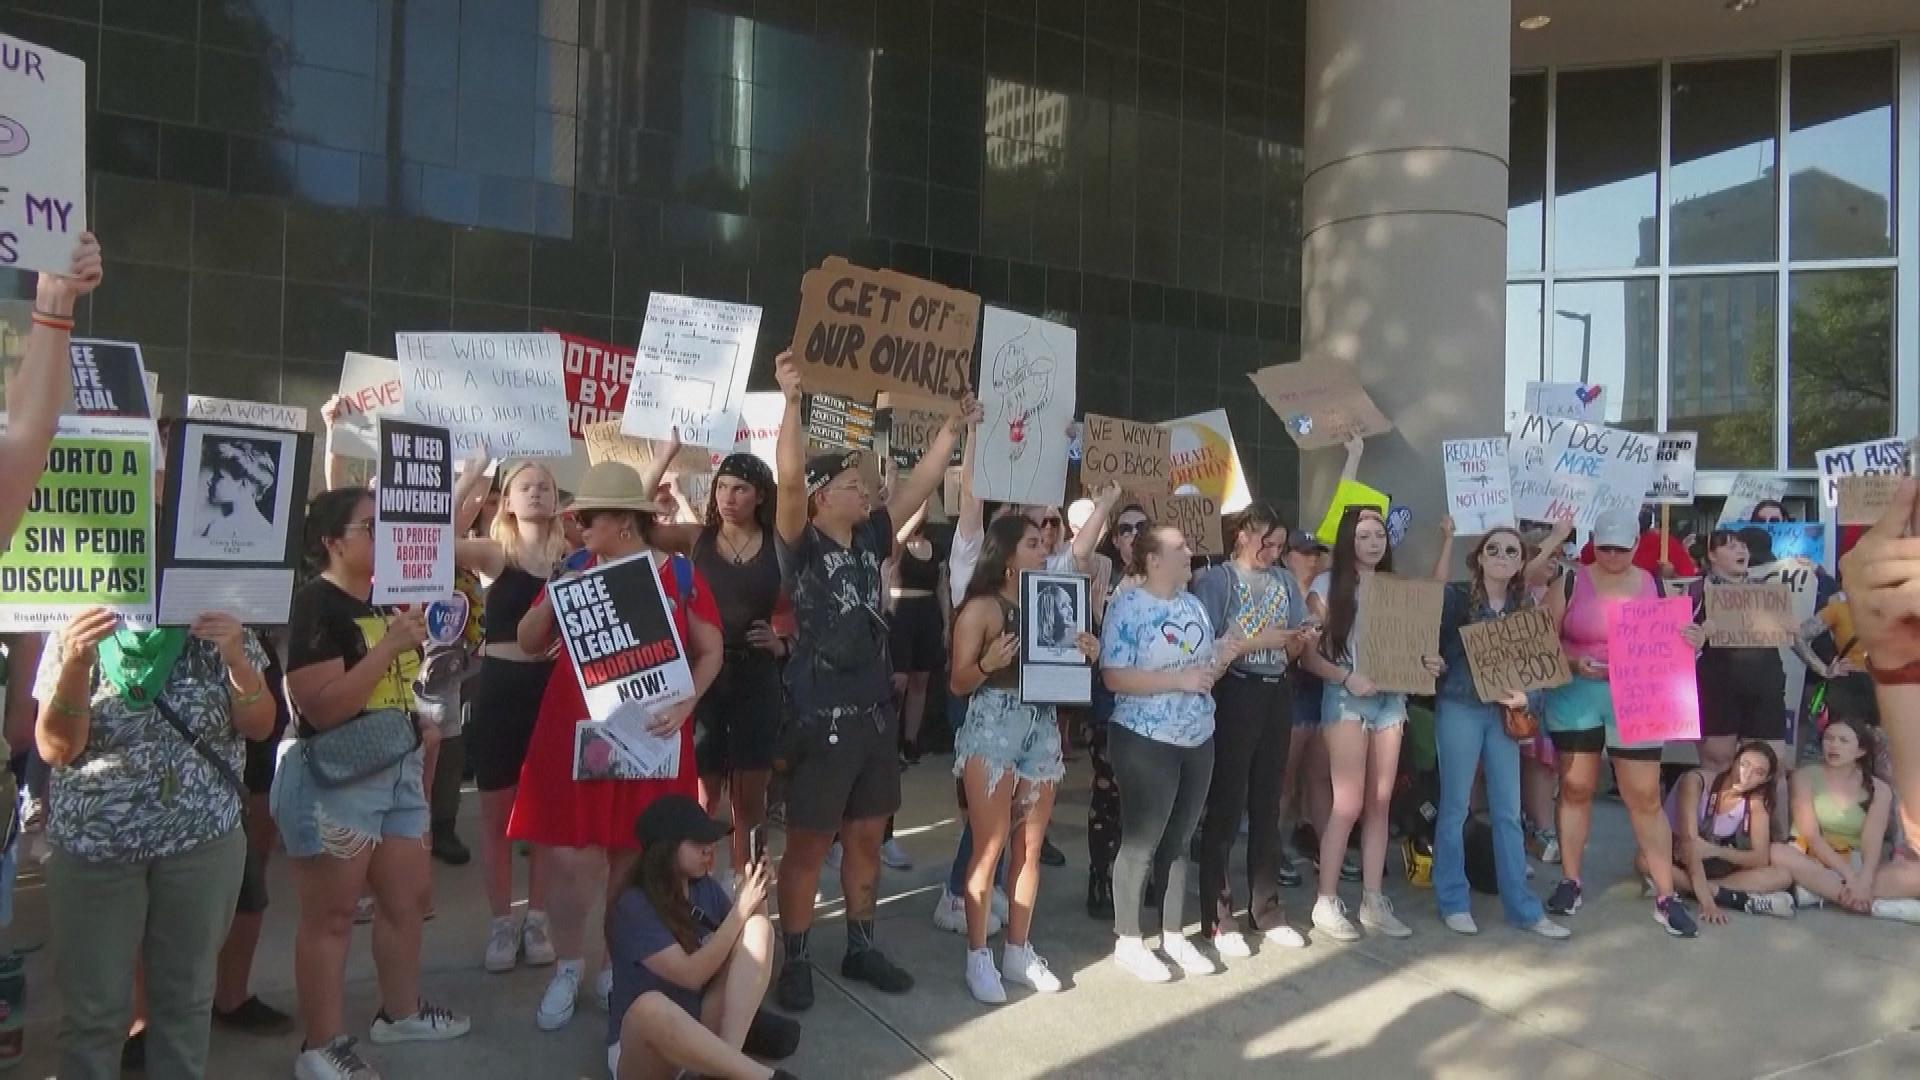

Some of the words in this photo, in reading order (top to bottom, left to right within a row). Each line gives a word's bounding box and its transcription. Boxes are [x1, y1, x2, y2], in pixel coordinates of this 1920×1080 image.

[26, 192, 73, 233] MY
[827, 277, 901, 323] GET
[908, 296, 956, 333] OFF
[450, 337, 496, 360] WHO
[505, 338, 552, 360] HATH
[804, 320, 866, 370] OUR
[869, 334, 971, 398] OVARIES
[560, 339, 634, 385] OTHE
[413, 368, 445, 391] NOT
[464, 369, 479, 389] A
[492, 368, 556, 389] UTERUS
[345, 380, 401, 415] NEVE
[580, 378, 620, 409] BY
[812, 394, 845, 410] ABORTION
[190, 399, 215, 414] AS
[220, 402, 233, 417] A
[415, 402, 483, 425] SHOULD
[493, 406, 526, 422] SHUT
[531, 404, 560, 422] THE
[811, 410, 844, 425] ABORTION
[809, 426, 843, 441] ABORTION
[1089, 420, 1113, 441] WE
[1122, 424, 1167, 449] WON'T
[1521, 414, 1563, 444] MY
[1568, 423, 1609, 455] DOG
[1616, 437, 1650, 464] HAS
[391, 433, 412, 457] WE
[415, 437, 443, 461] NEED
[1446, 440, 1504, 462] REGULATE
[43, 447, 113, 475] ORTO
[122, 449, 138, 475] A
[1086, 446, 1118, 473] GO
[1124, 453, 1163, 478] BACK
[1461, 461, 1487, 473] THIS
[1554, 451, 1605, 476] MORE
[1824, 452, 1855, 476] MY
[394, 462, 402, 484] A
[406, 465, 442, 488] MASS
[382, 489, 450, 514] MOVEMENT
[1166, 498, 1214, 519] STAND
[1456, 494, 1480, 508] NOT
[1482, 490, 1505, 506] THIS
[25, 527, 65, 553] SIN
[75, 528, 145, 554] PEDIR
[393, 527, 403, 542] TO
[406, 528, 441, 543] PROTECT
[397, 545, 438, 560] ABORTION
[402, 563, 432, 580] RIGHTS
[556, 575, 610, 612] FREE
[1711, 588, 1787, 611] ABORTION
[565, 600, 620, 637] SAFE
[573, 621, 640, 663] LEGAL
[581, 639, 677, 686] ABORTIONS
[1514, 648, 1566, 687] BODY
[616, 669, 669, 703] NOW!
